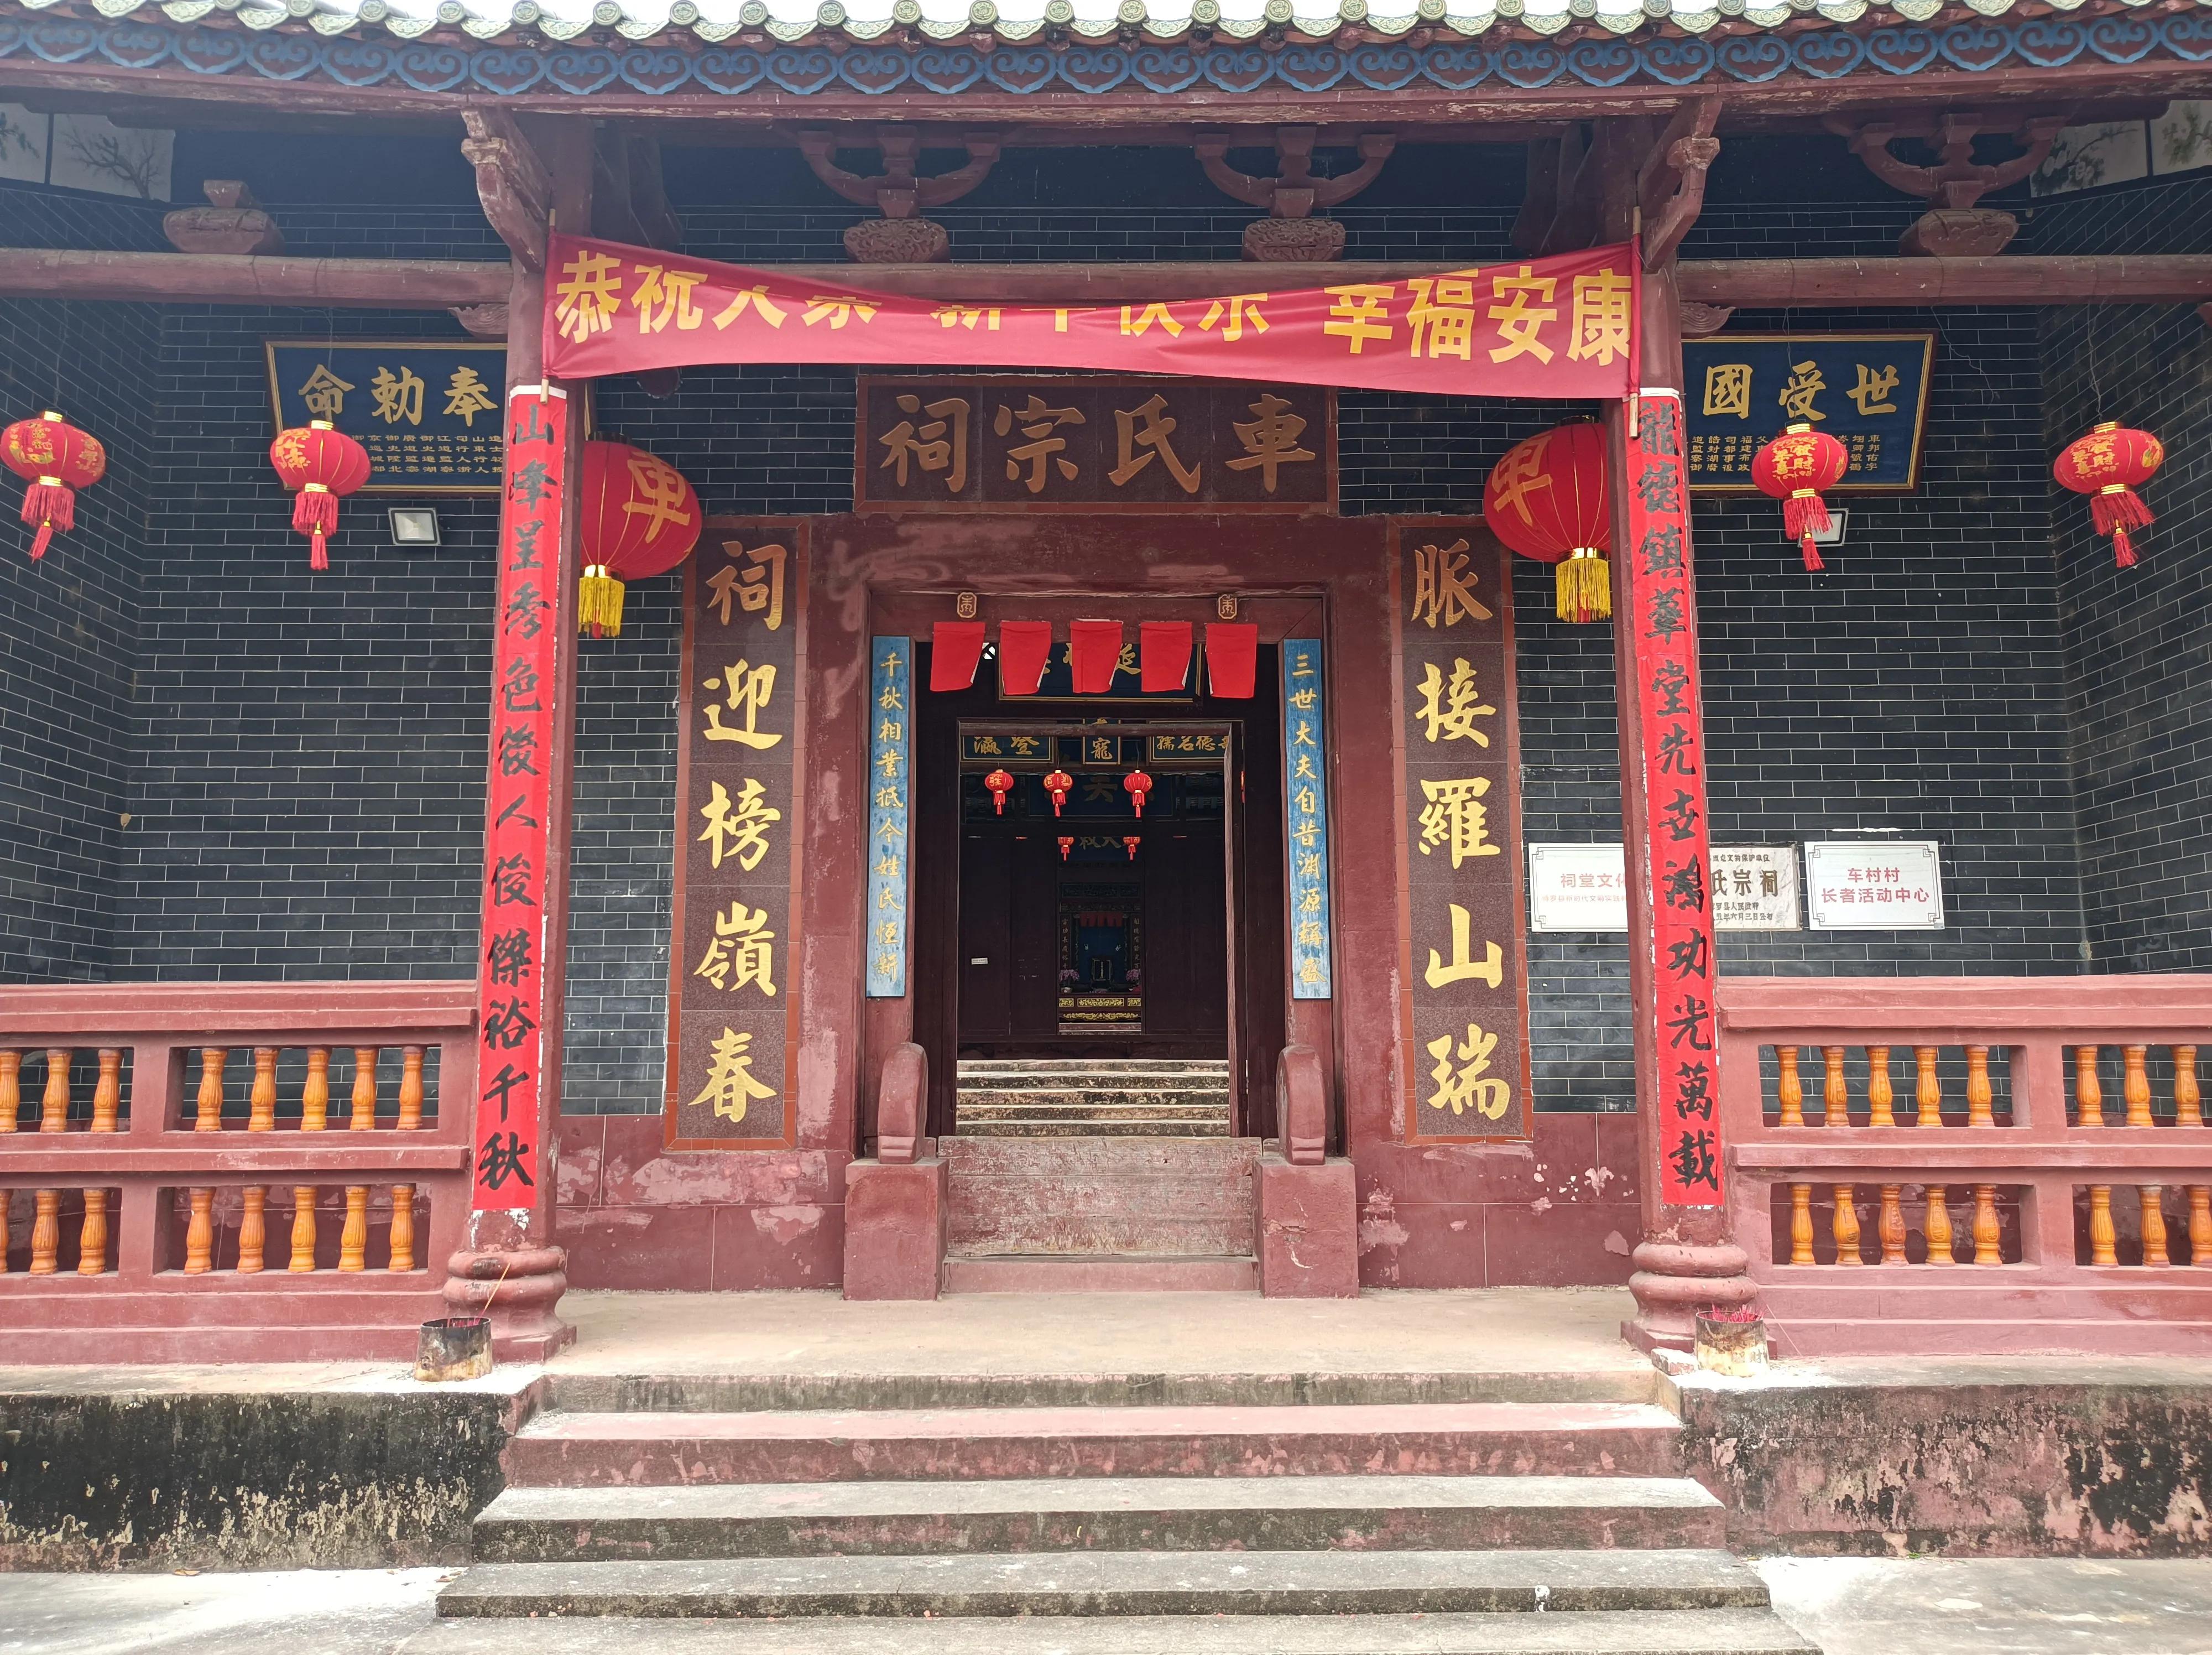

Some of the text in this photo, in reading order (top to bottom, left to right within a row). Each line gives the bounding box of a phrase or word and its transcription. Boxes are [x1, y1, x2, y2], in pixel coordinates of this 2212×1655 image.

[1323, 266, 1632, 367] 幸福安康
[1702, 360, 1900, 421] 世受國
[879, 393, 1316, 494] 車氏宗祠
[623, 449, 690, 543] 車
[687, 540, 787, 1123] 祠迎榜嶺春
[1411, 538, 1510, 1121] 脈接羅山瑞
[1710, 853, 1770, 862] 重点文物保护单位
[1821, 887, 1929, 904] 长者活动中心
[1847, 867, 1901, 882] 车村村
[1713, 902, 1760, 911] 罗县人民政府
[1713, 912, 1773, 921] 五年六月三日公布
